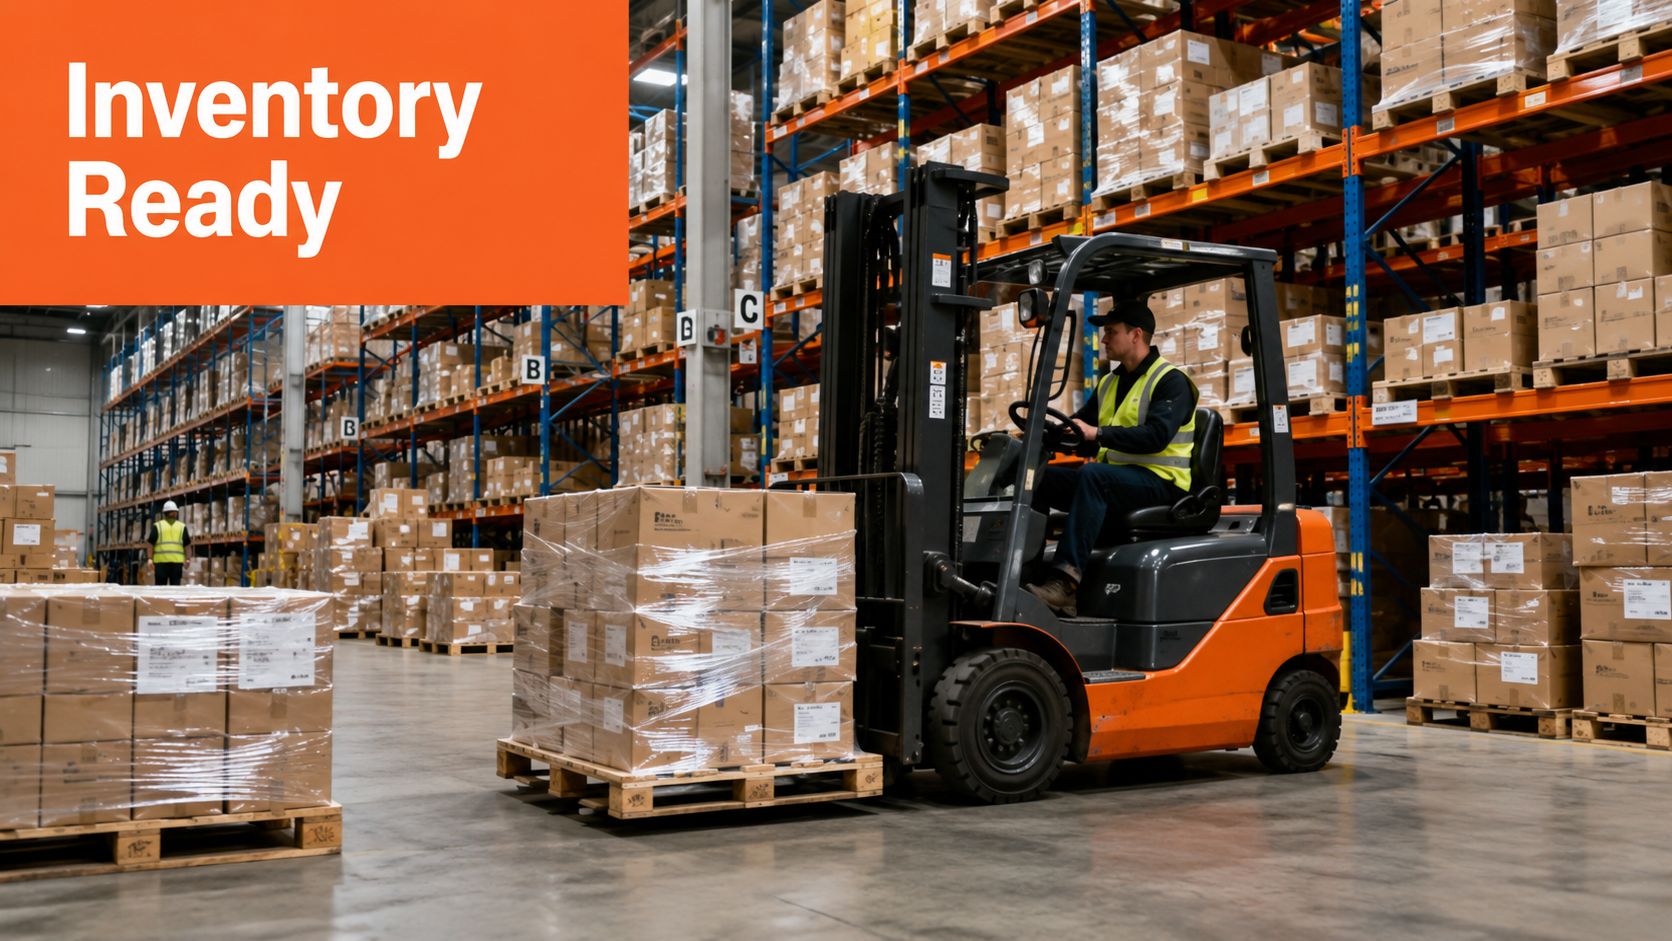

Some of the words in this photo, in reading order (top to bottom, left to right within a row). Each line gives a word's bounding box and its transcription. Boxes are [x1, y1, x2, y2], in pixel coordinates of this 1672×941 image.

[740, 294, 758, 323] C
[527, 359, 540, 379] B
[344, 420, 355, 436] B
